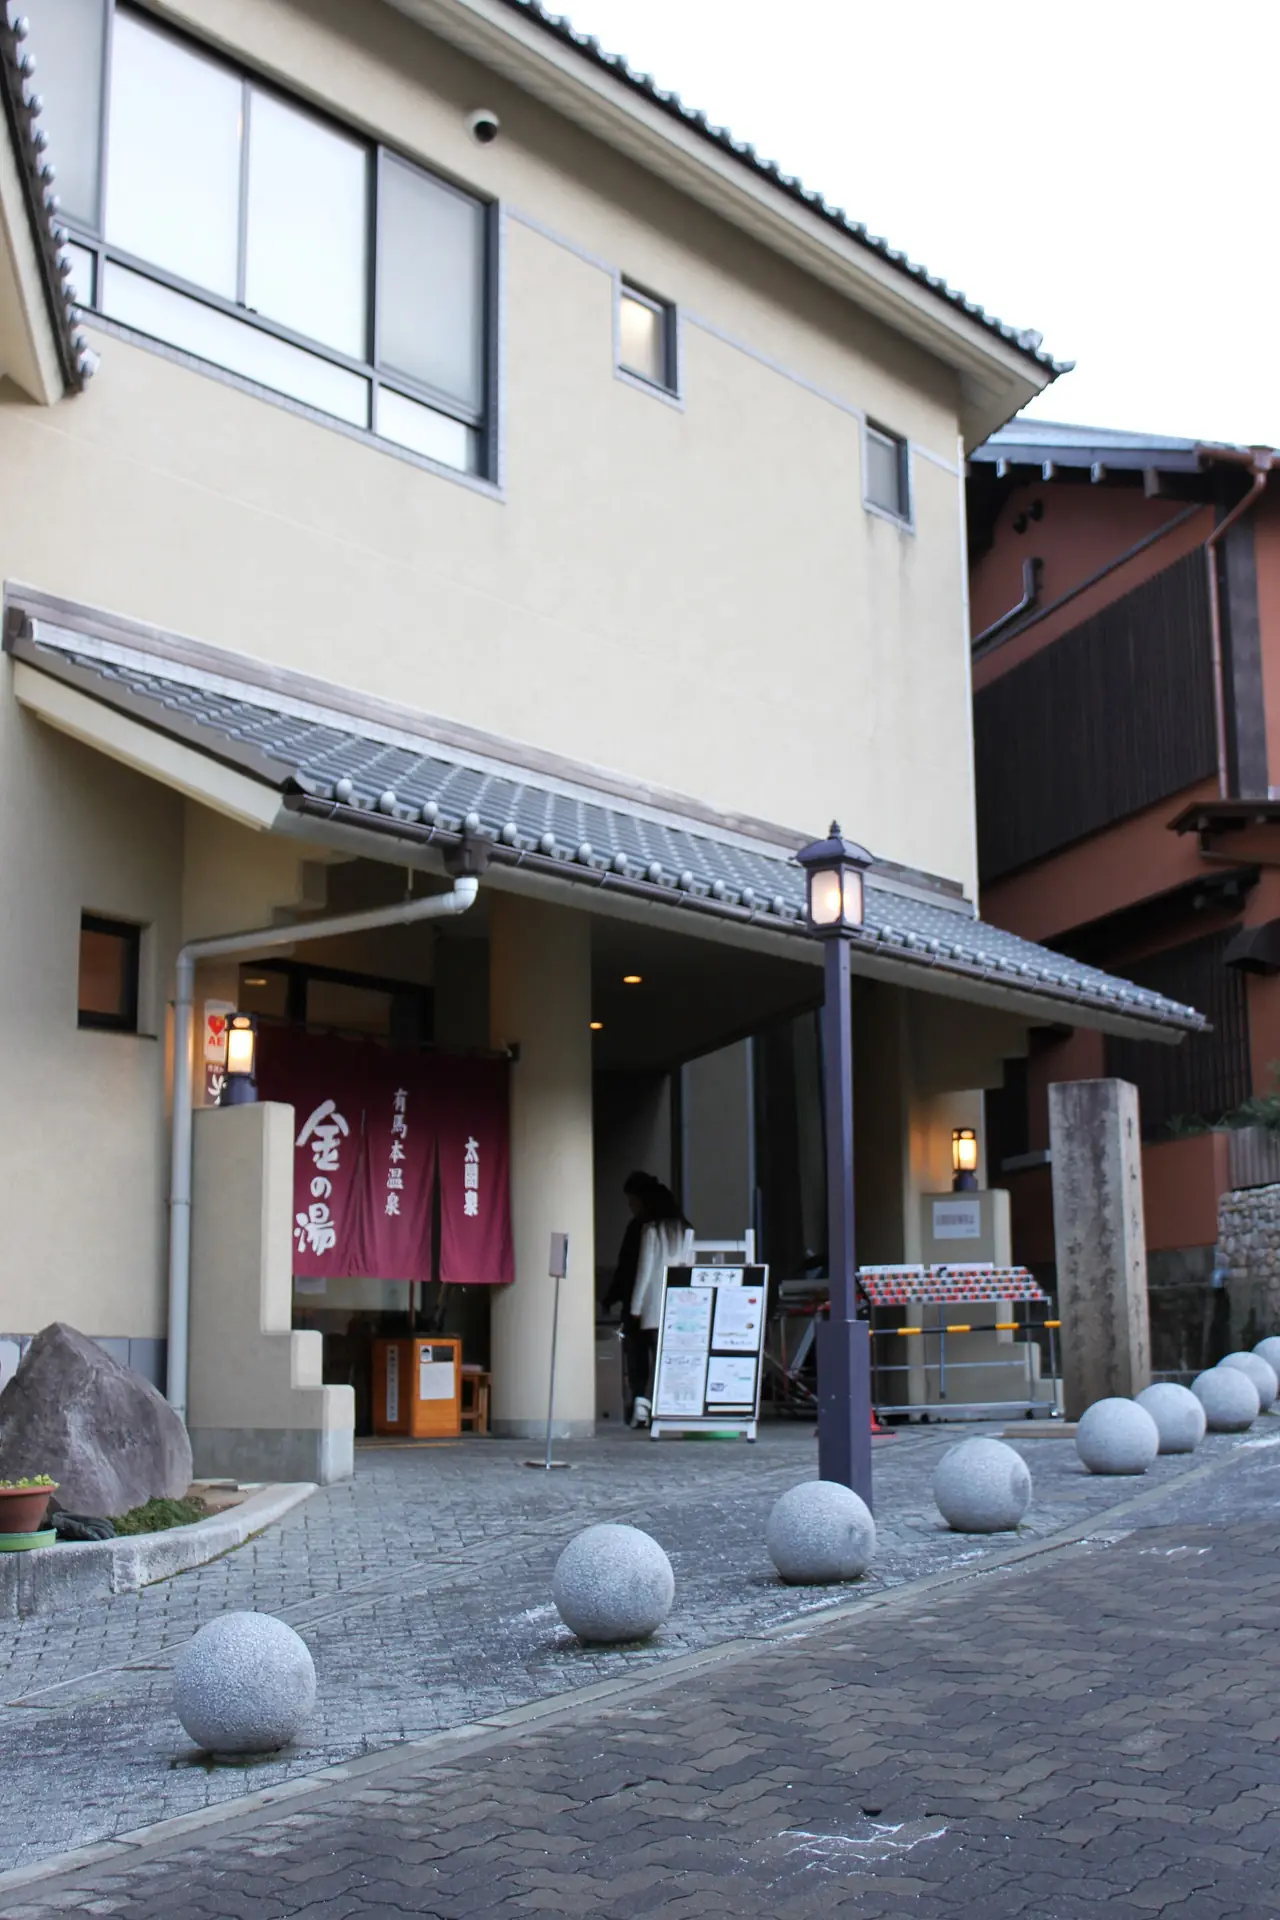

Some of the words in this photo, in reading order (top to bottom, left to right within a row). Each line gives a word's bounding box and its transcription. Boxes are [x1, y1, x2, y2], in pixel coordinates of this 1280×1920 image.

[294, 1099, 350, 1256] 金の湯
[385, 1088, 408, 1216] 有馬本温泉
[464, 1136, 479, 1217] 太閤泉
